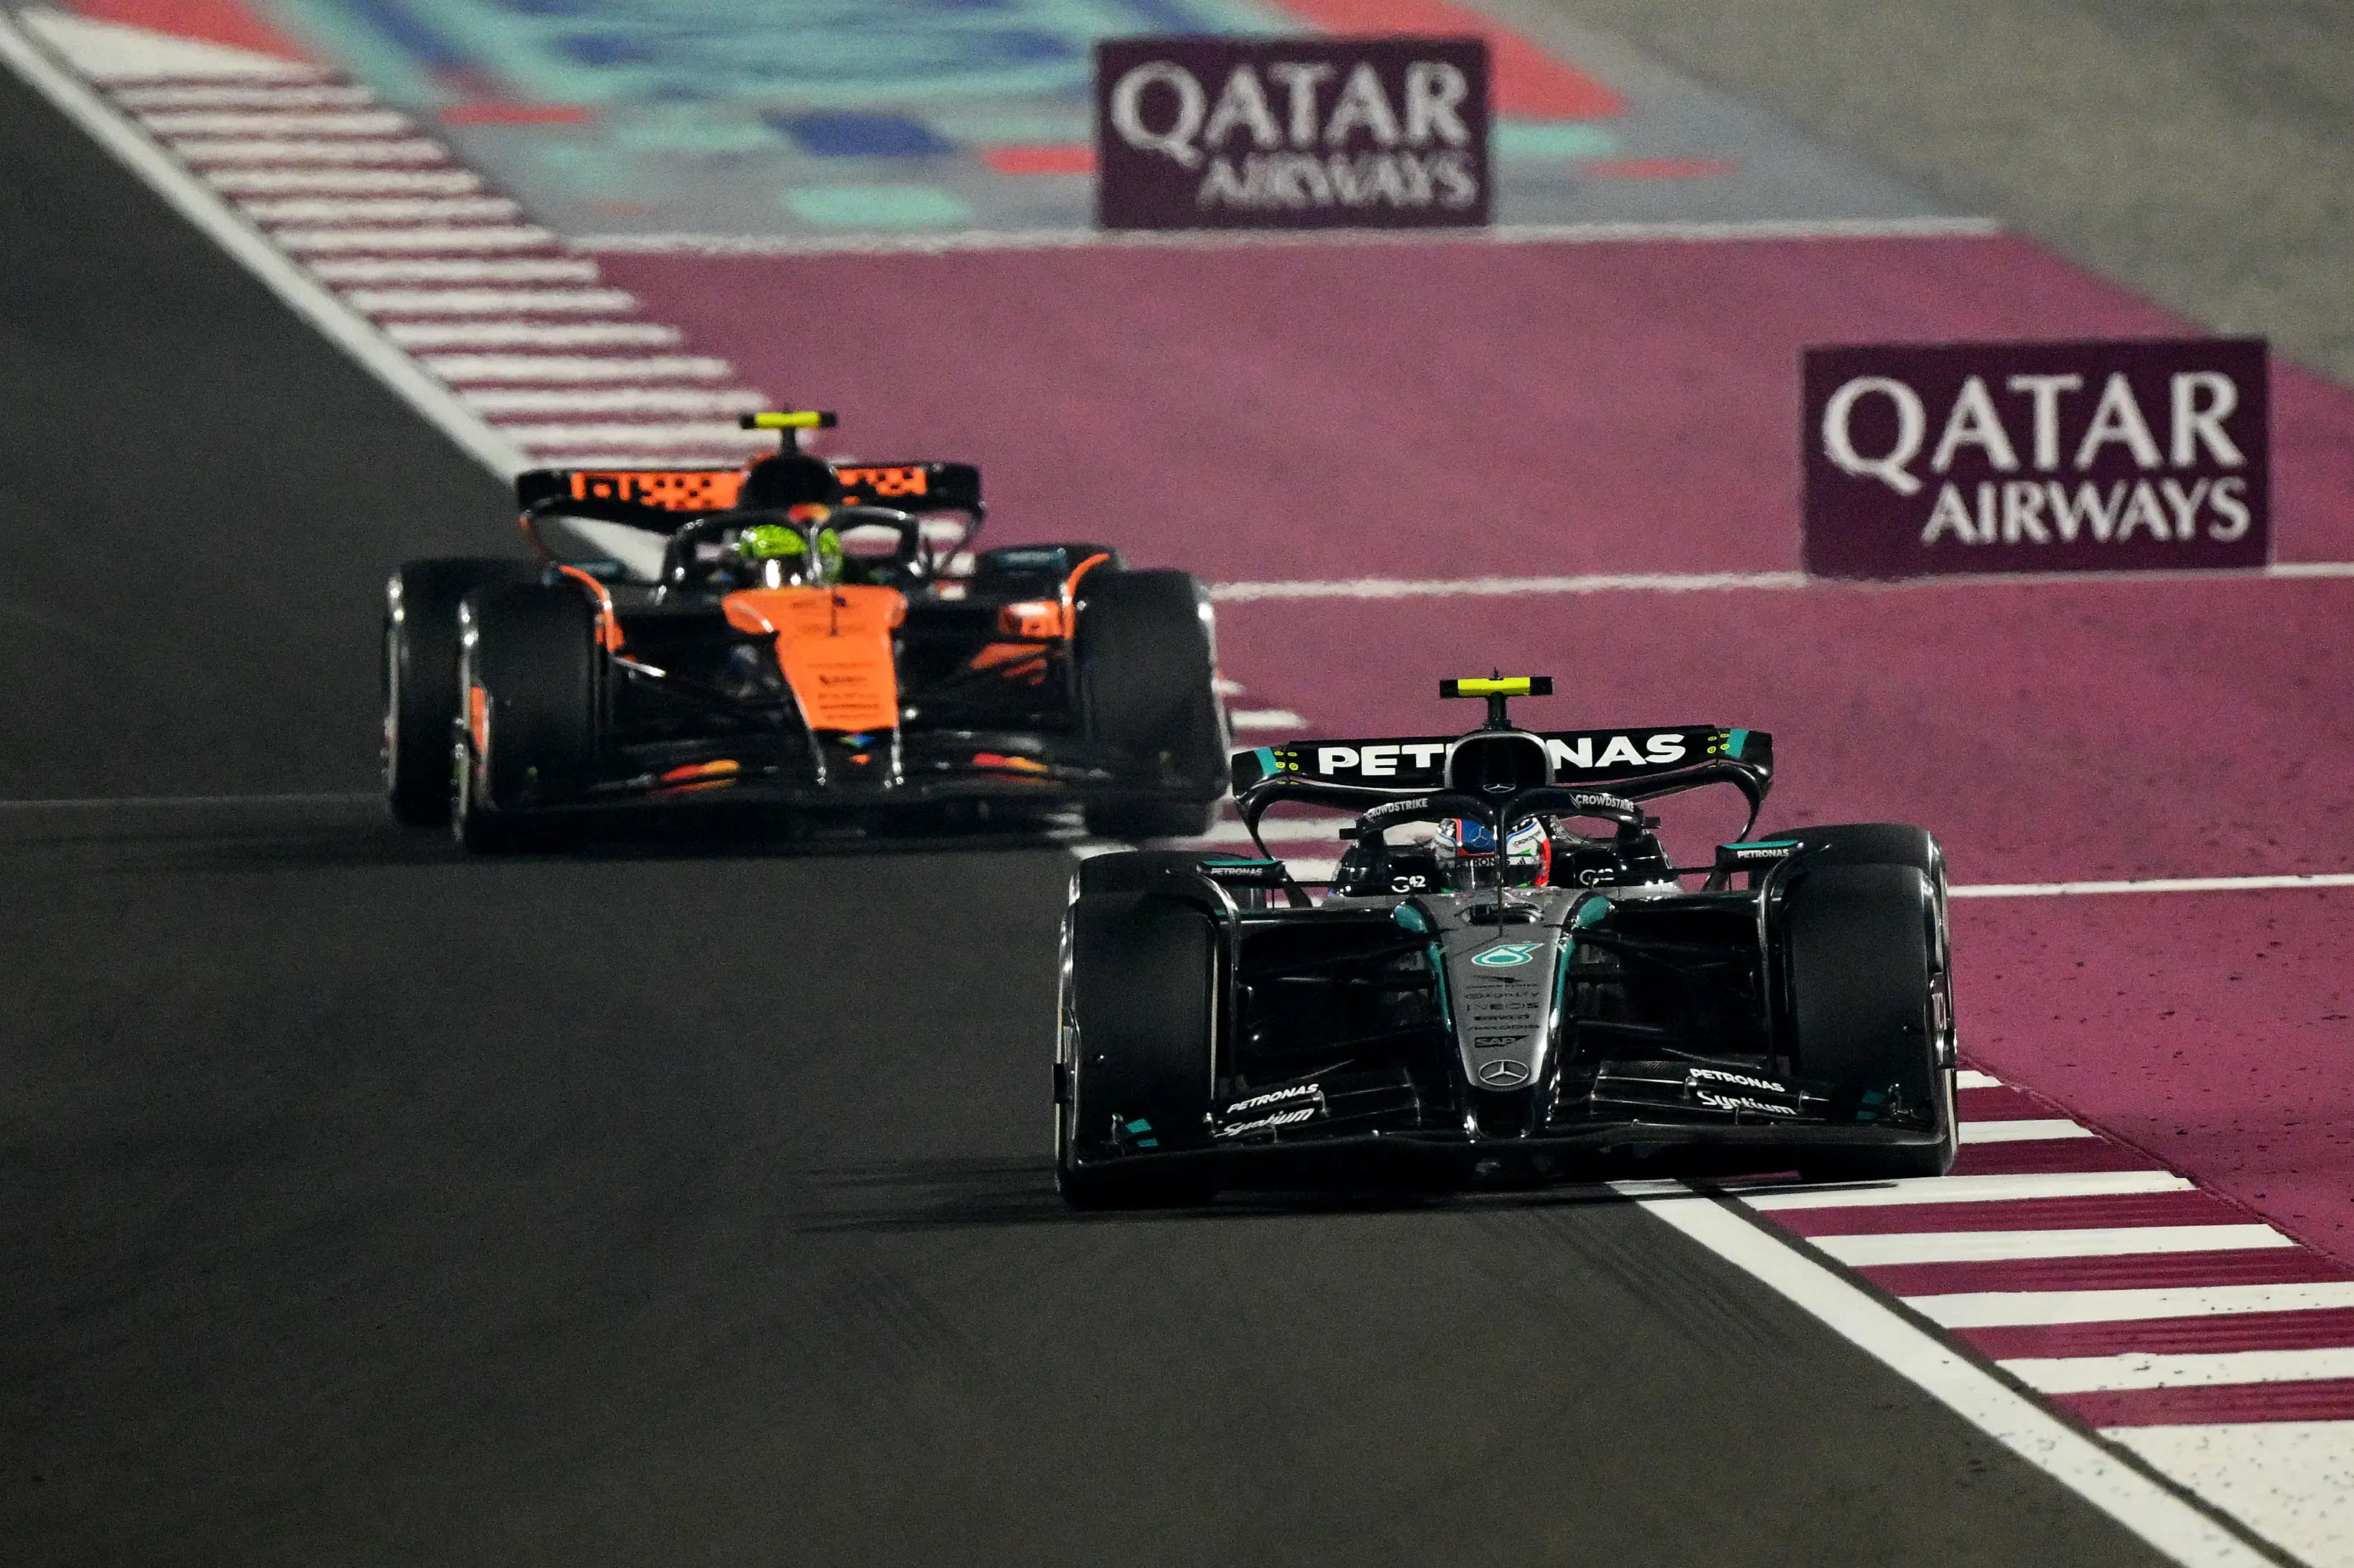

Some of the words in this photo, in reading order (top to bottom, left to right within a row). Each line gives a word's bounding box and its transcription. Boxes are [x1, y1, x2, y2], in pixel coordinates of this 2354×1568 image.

[1111, 60, 1472, 170] QATAR
[1196, 151, 1480, 209] AIRWAYS
[1822, 371, 2248, 495] QATAR
[1921, 476, 2251, 545] AIRWAYS
[1318, 733, 1686, 776] PETNAS
[1365, 797, 1428, 820] CROWDSTRIKE
[1575, 792, 1635, 812] CROWDSTRIKE
[1455, 857, 1510, 868] PETRONS
[1737, 848, 1789, 859] PETRONAS
[1391, 875, 1426, 893] G42
[1689, 1068, 1786, 1093] PETRONAS
[1226, 1083, 1319, 1113] PETRONAS
